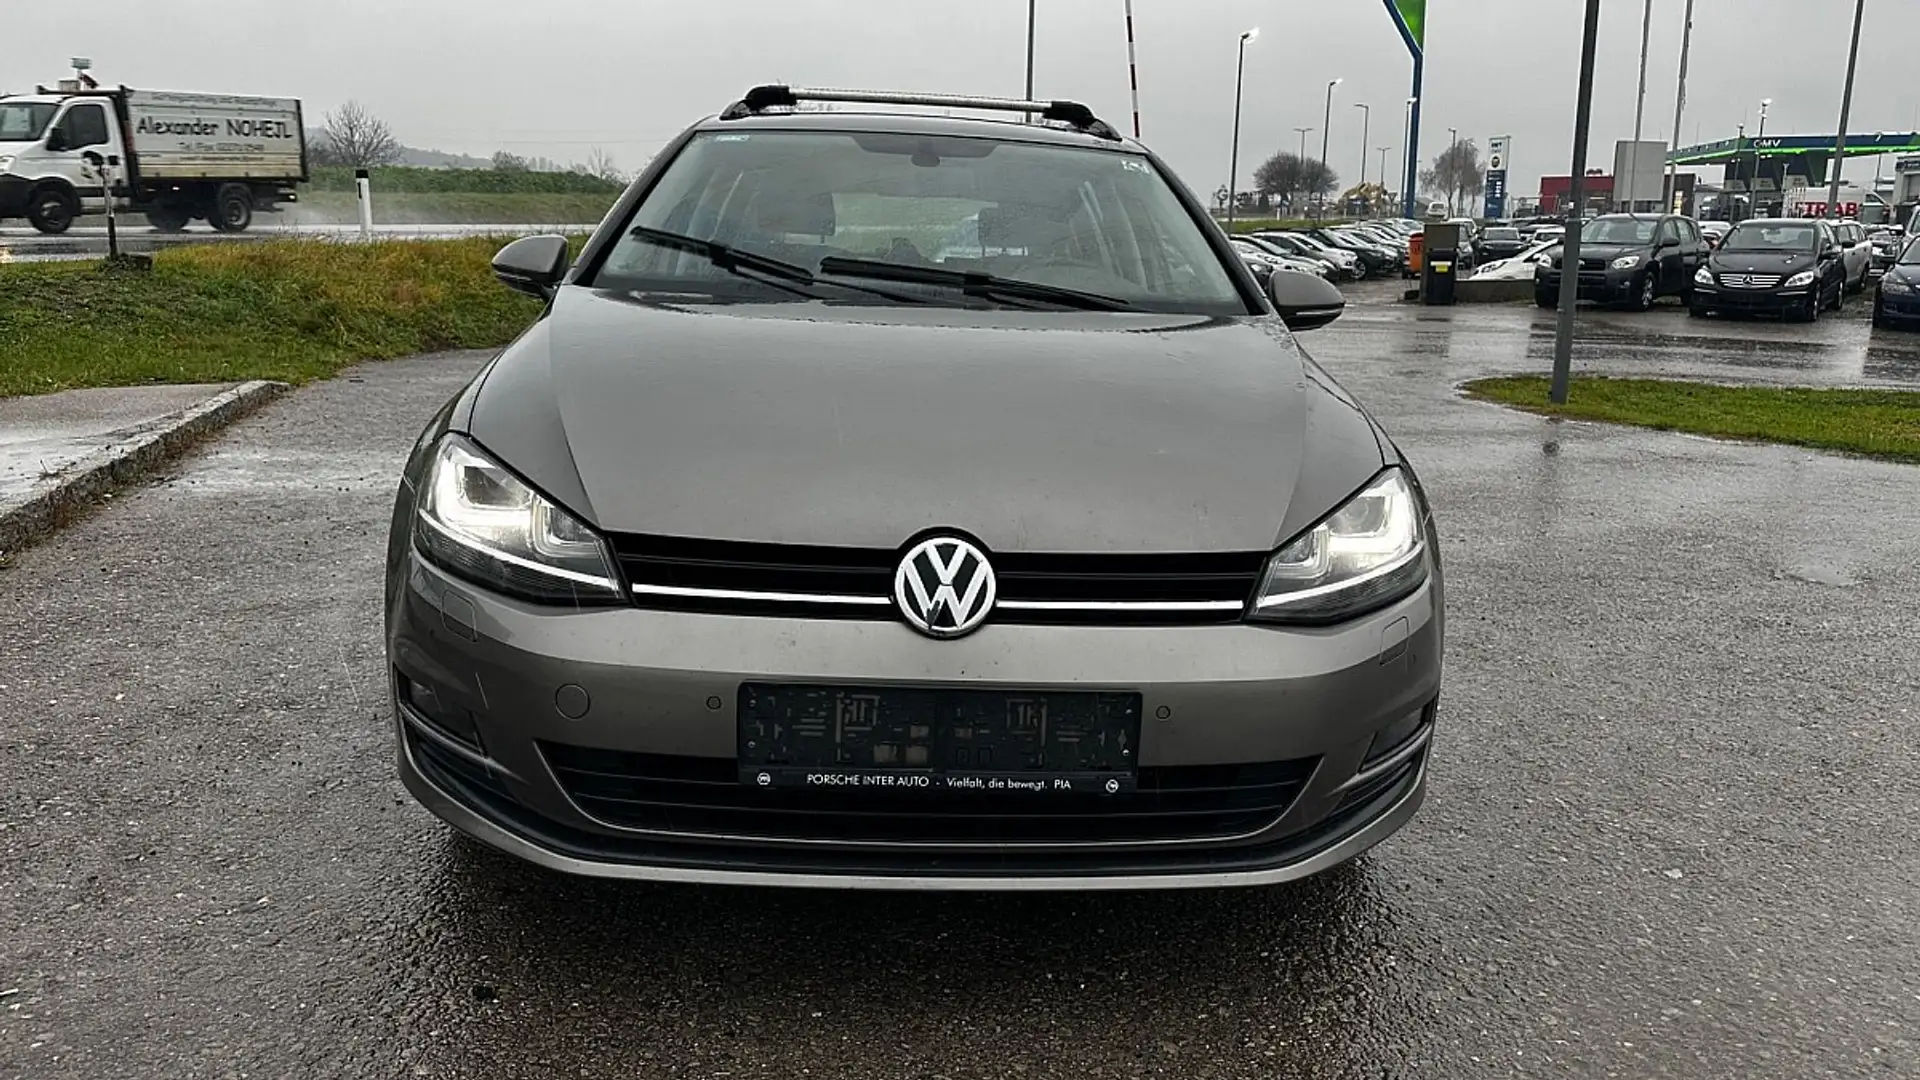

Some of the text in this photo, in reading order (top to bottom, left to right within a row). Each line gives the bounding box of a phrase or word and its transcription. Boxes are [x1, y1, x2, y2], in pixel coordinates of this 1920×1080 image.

[136, 116, 219, 136] Alexander
[807, 774, 860, 785] PORSCHE
[863, 775, 894, 786] INTER
[897, 776, 930, 787] AUTO
[946, 777, 985, 789] Vielfalt,
[988, 777, 1004, 788] die
[1008, 778, 1048, 791] bewegt.
[1054, 779, 1072, 789] PIA
